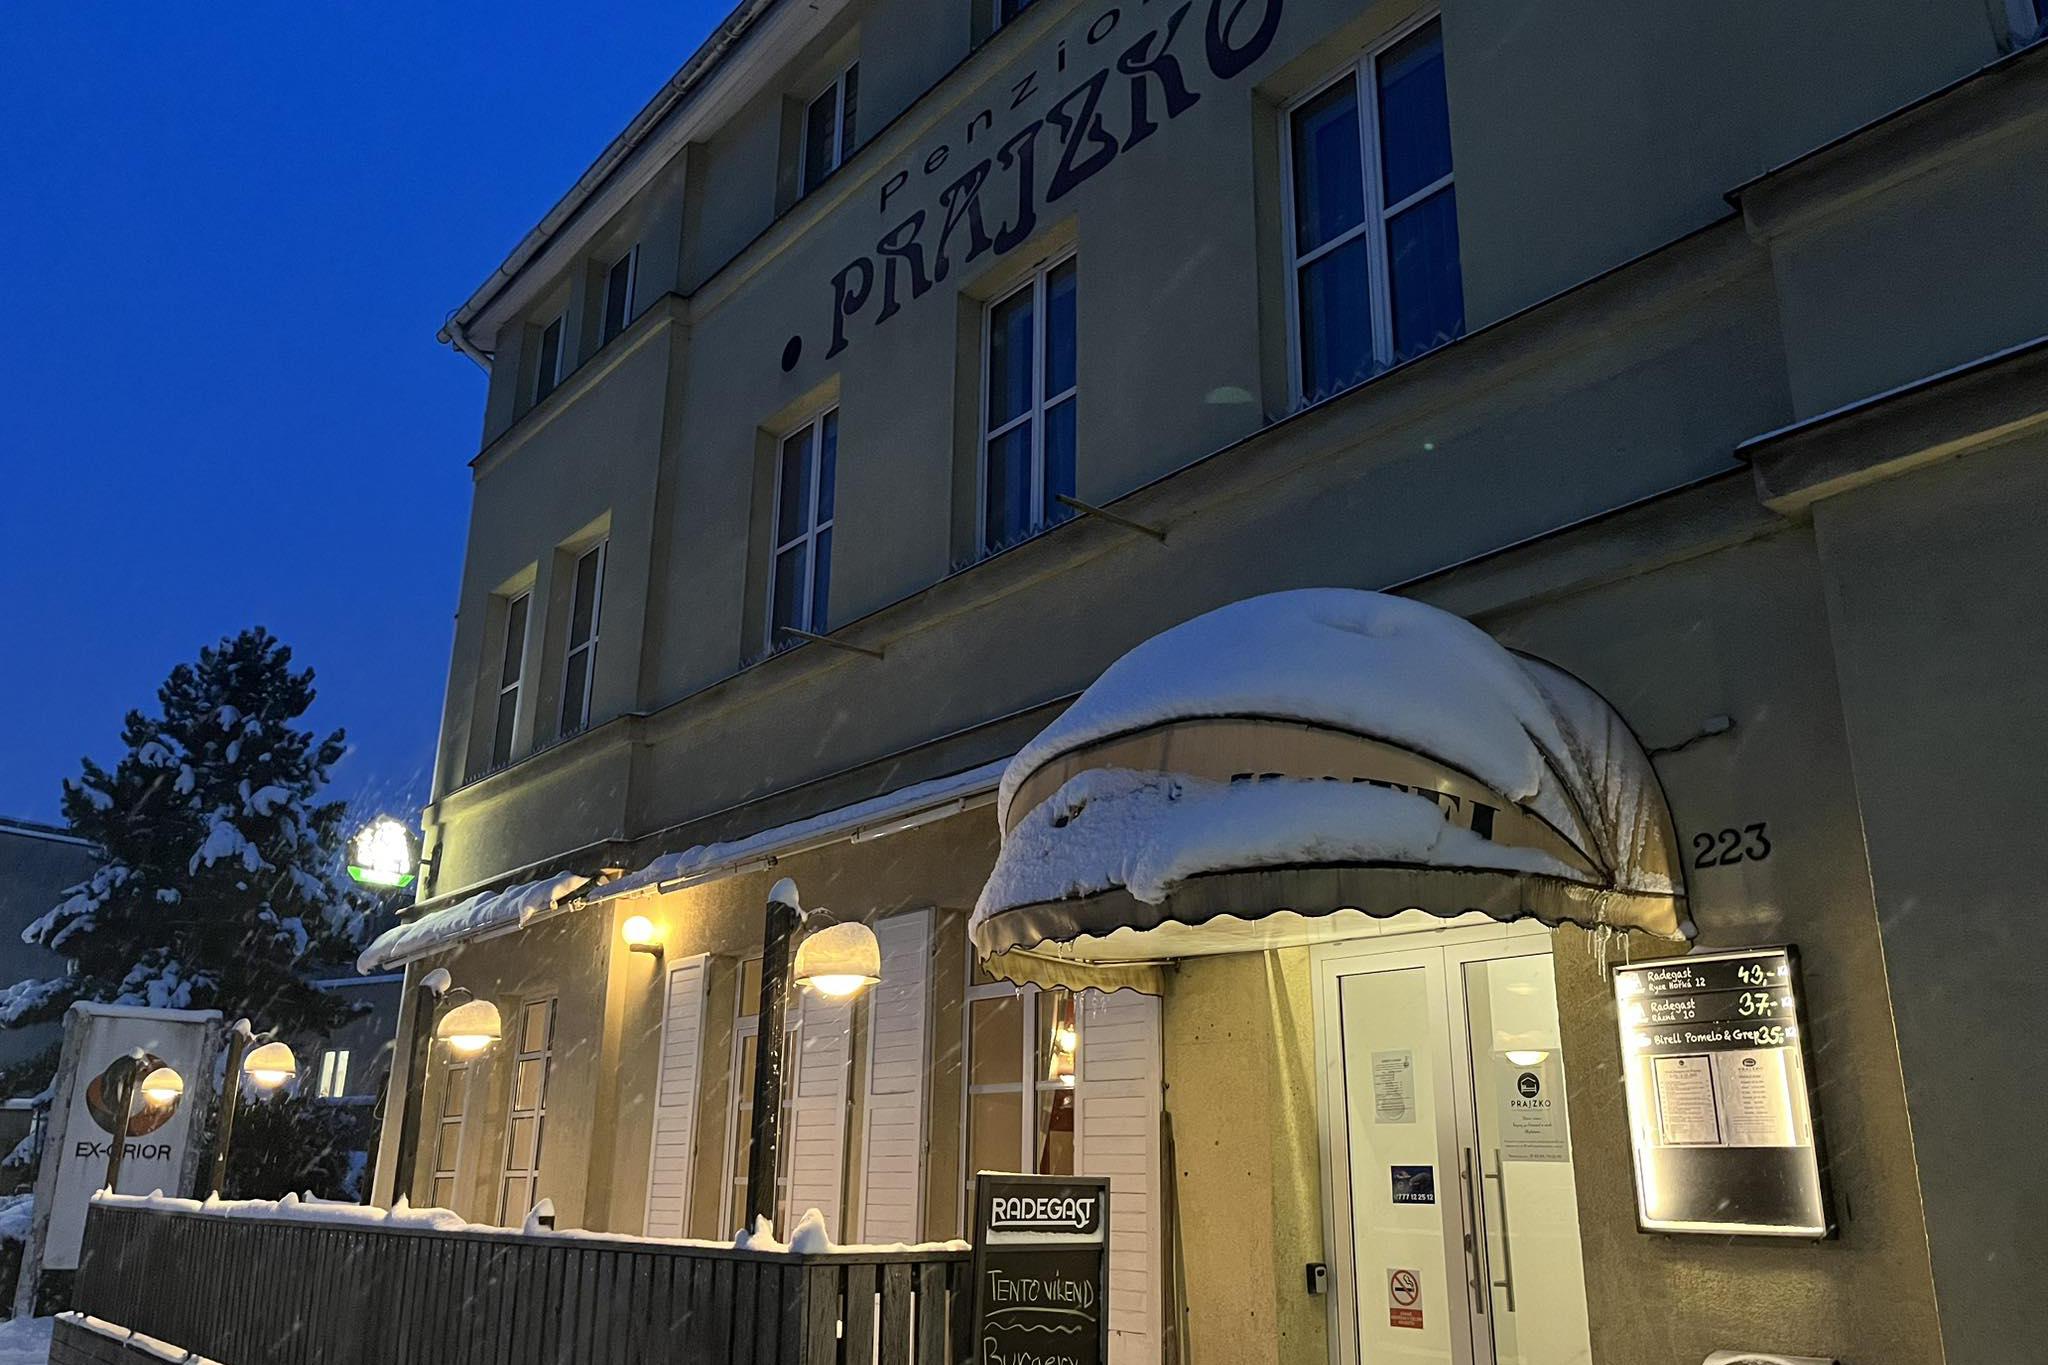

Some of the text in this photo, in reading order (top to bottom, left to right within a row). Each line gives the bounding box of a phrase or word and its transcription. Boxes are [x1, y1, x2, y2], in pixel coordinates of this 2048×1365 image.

[880, 0, 1148, 214] Penzio
[825, 0, 1284, 360] PRAJZKO
[1693, 822, 1771, 868] 223
[1647, 967, 1692, 983] Radegast
[1695, 977, 1706, 987] 12
[1650, 998, 1695, 1014] Radegast
[1683, 1010, 1695, 1020] 10
[1654, 1033, 1681, 1045] Birell
[1685, 1031, 1722, 1043] Pomelo
[1723, 1030, 1732, 1041] &
[1510, 1100, 1551, 1108] PRAJZKO
[76, 1142, 172, 1160] EX-RIOR
[991, 1197, 1096, 1229] RADEGAST
